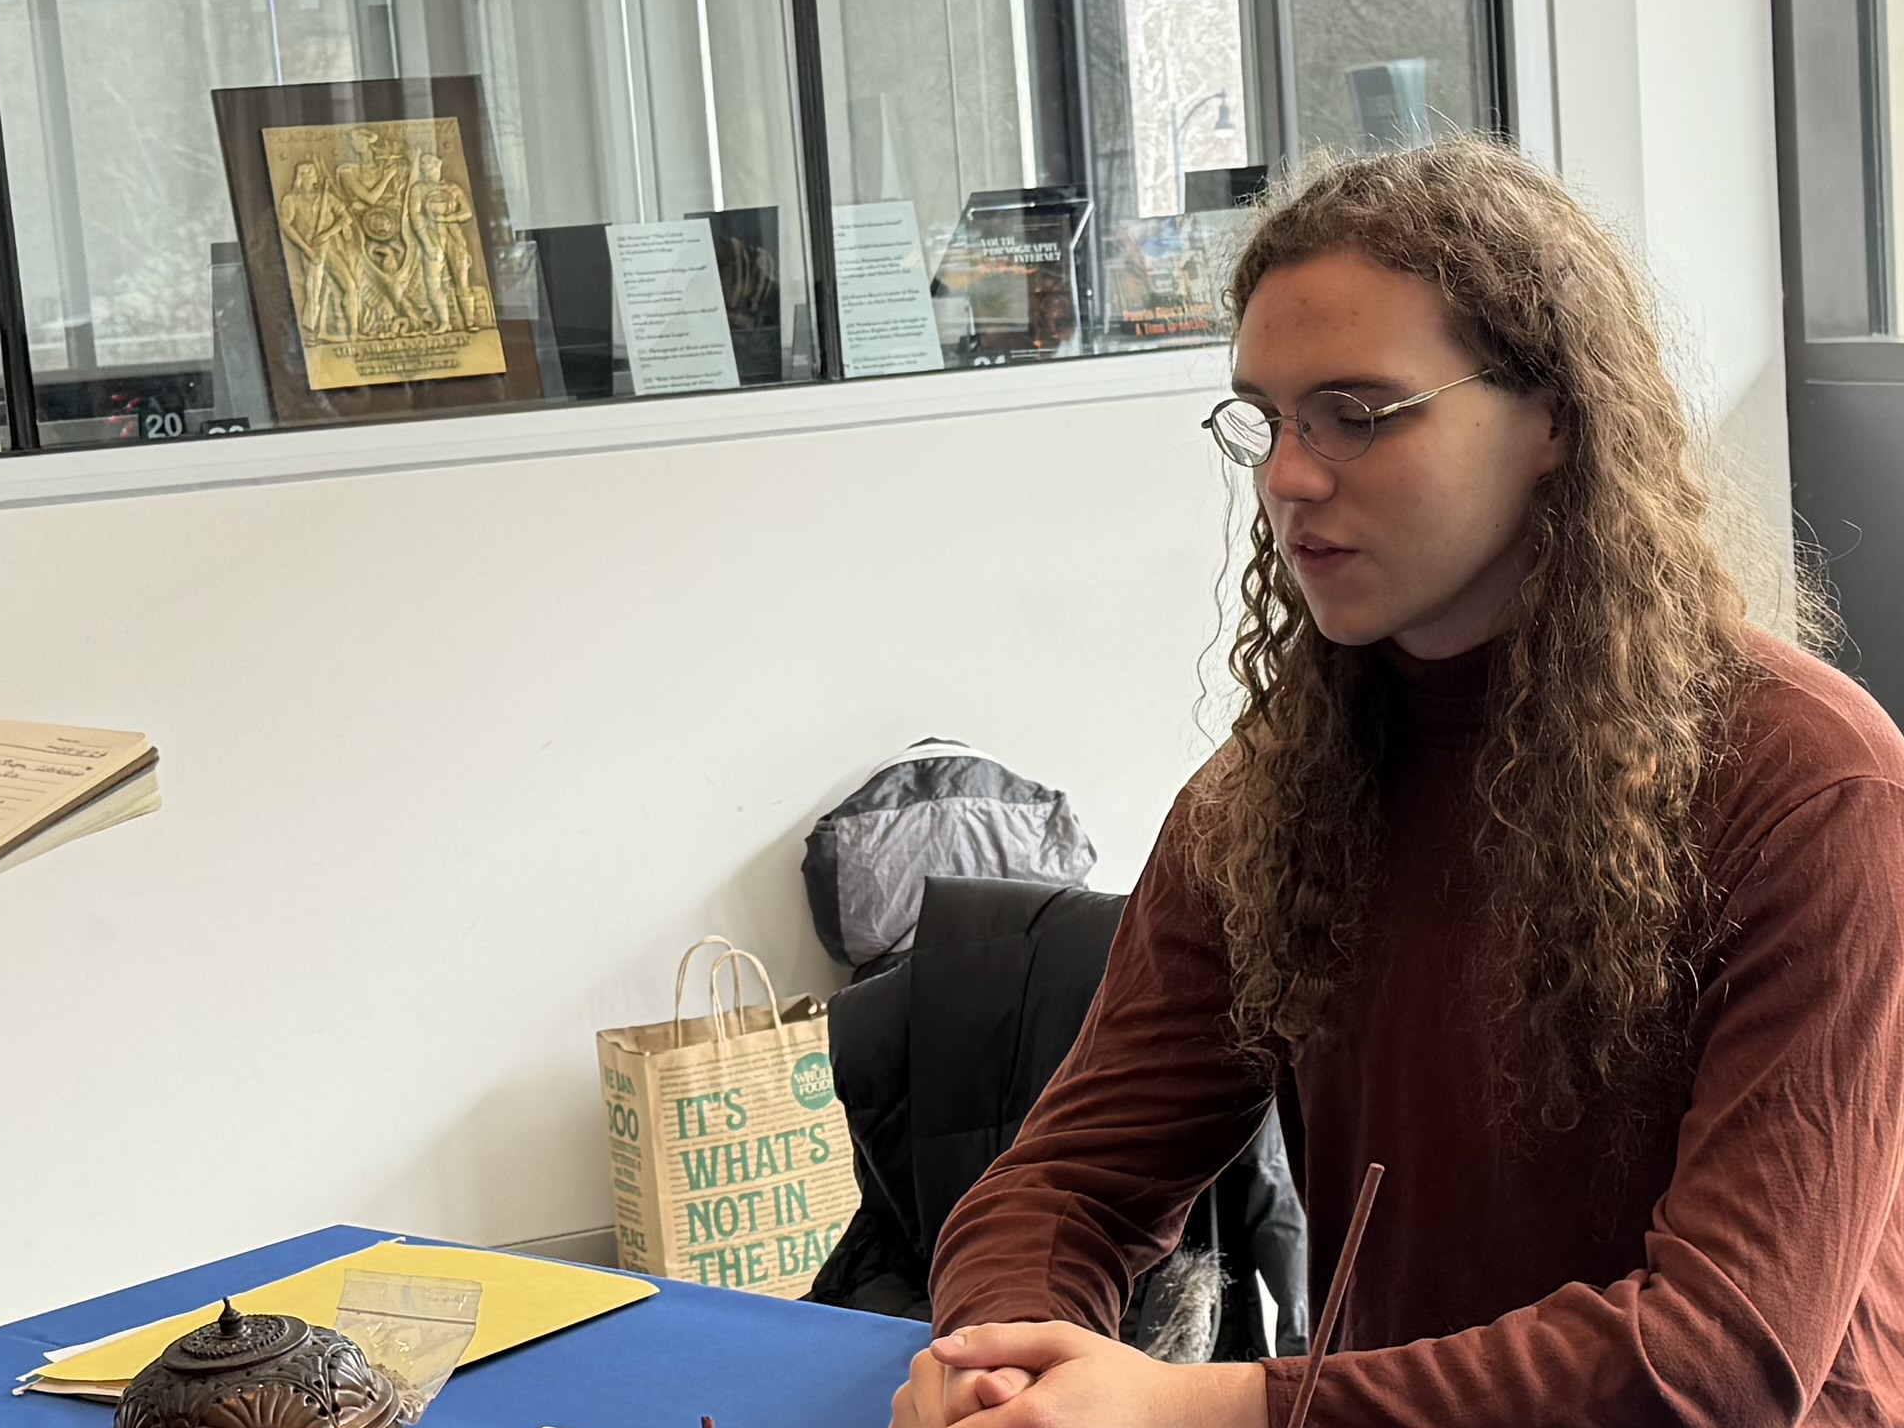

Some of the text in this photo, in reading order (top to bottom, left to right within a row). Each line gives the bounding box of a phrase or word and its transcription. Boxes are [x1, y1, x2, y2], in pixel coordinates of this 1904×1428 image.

[145, 412, 183, 439] 20
[605, 1099, 640, 1142] 300
[675, 1088, 748, 1140] IT'S
[678, 1122, 831, 1192] WHAT'S
[685, 1179, 812, 1245] NOT IN
[688, 1241, 770, 1290] THE
